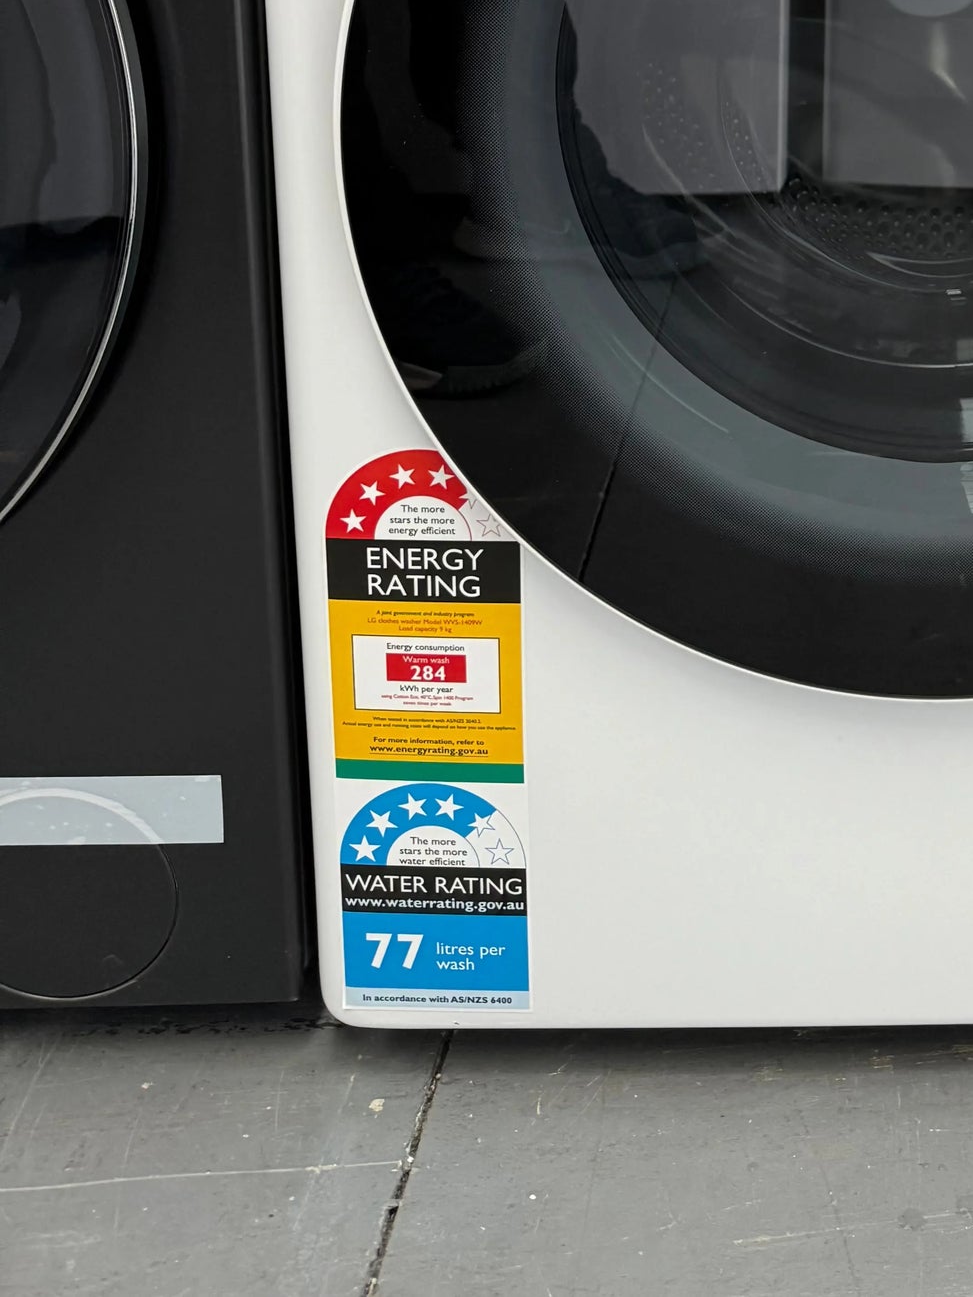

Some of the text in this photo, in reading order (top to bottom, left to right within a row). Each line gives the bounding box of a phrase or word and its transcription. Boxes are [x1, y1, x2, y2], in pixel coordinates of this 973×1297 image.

[400, 505, 419, 513] The
[413, 516, 428, 524] the
[430, 517, 455, 525] more
[388, 526, 456, 536] energy efficient
[366, 547, 484, 570] ENERGY
[367, 574, 481, 597] RATING
[386, 642, 465, 652] Energy consumption
[402, 655, 450, 664] Warm wash
[410, 665, 446, 681] 284
[399, 684, 453, 694] kWh per year
[410, 737, 455, 745] information,
[370, 744, 488, 756] www.energyrating.gov.au
[410, 836, 456, 846] The more
[399, 847, 468, 857] stars the more
[399, 856, 466, 866] water efficient
[345, 873, 523, 895] WATER RATING
[345, 896, 525, 913] www.waterrating.gov.au
[365, 932, 424, 970] 77
[436, 942, 506, 959] litres per
[436, 958, 475, 971] wash
[362, 994, 512, 1004] In accordance with AS/NZS 6400
